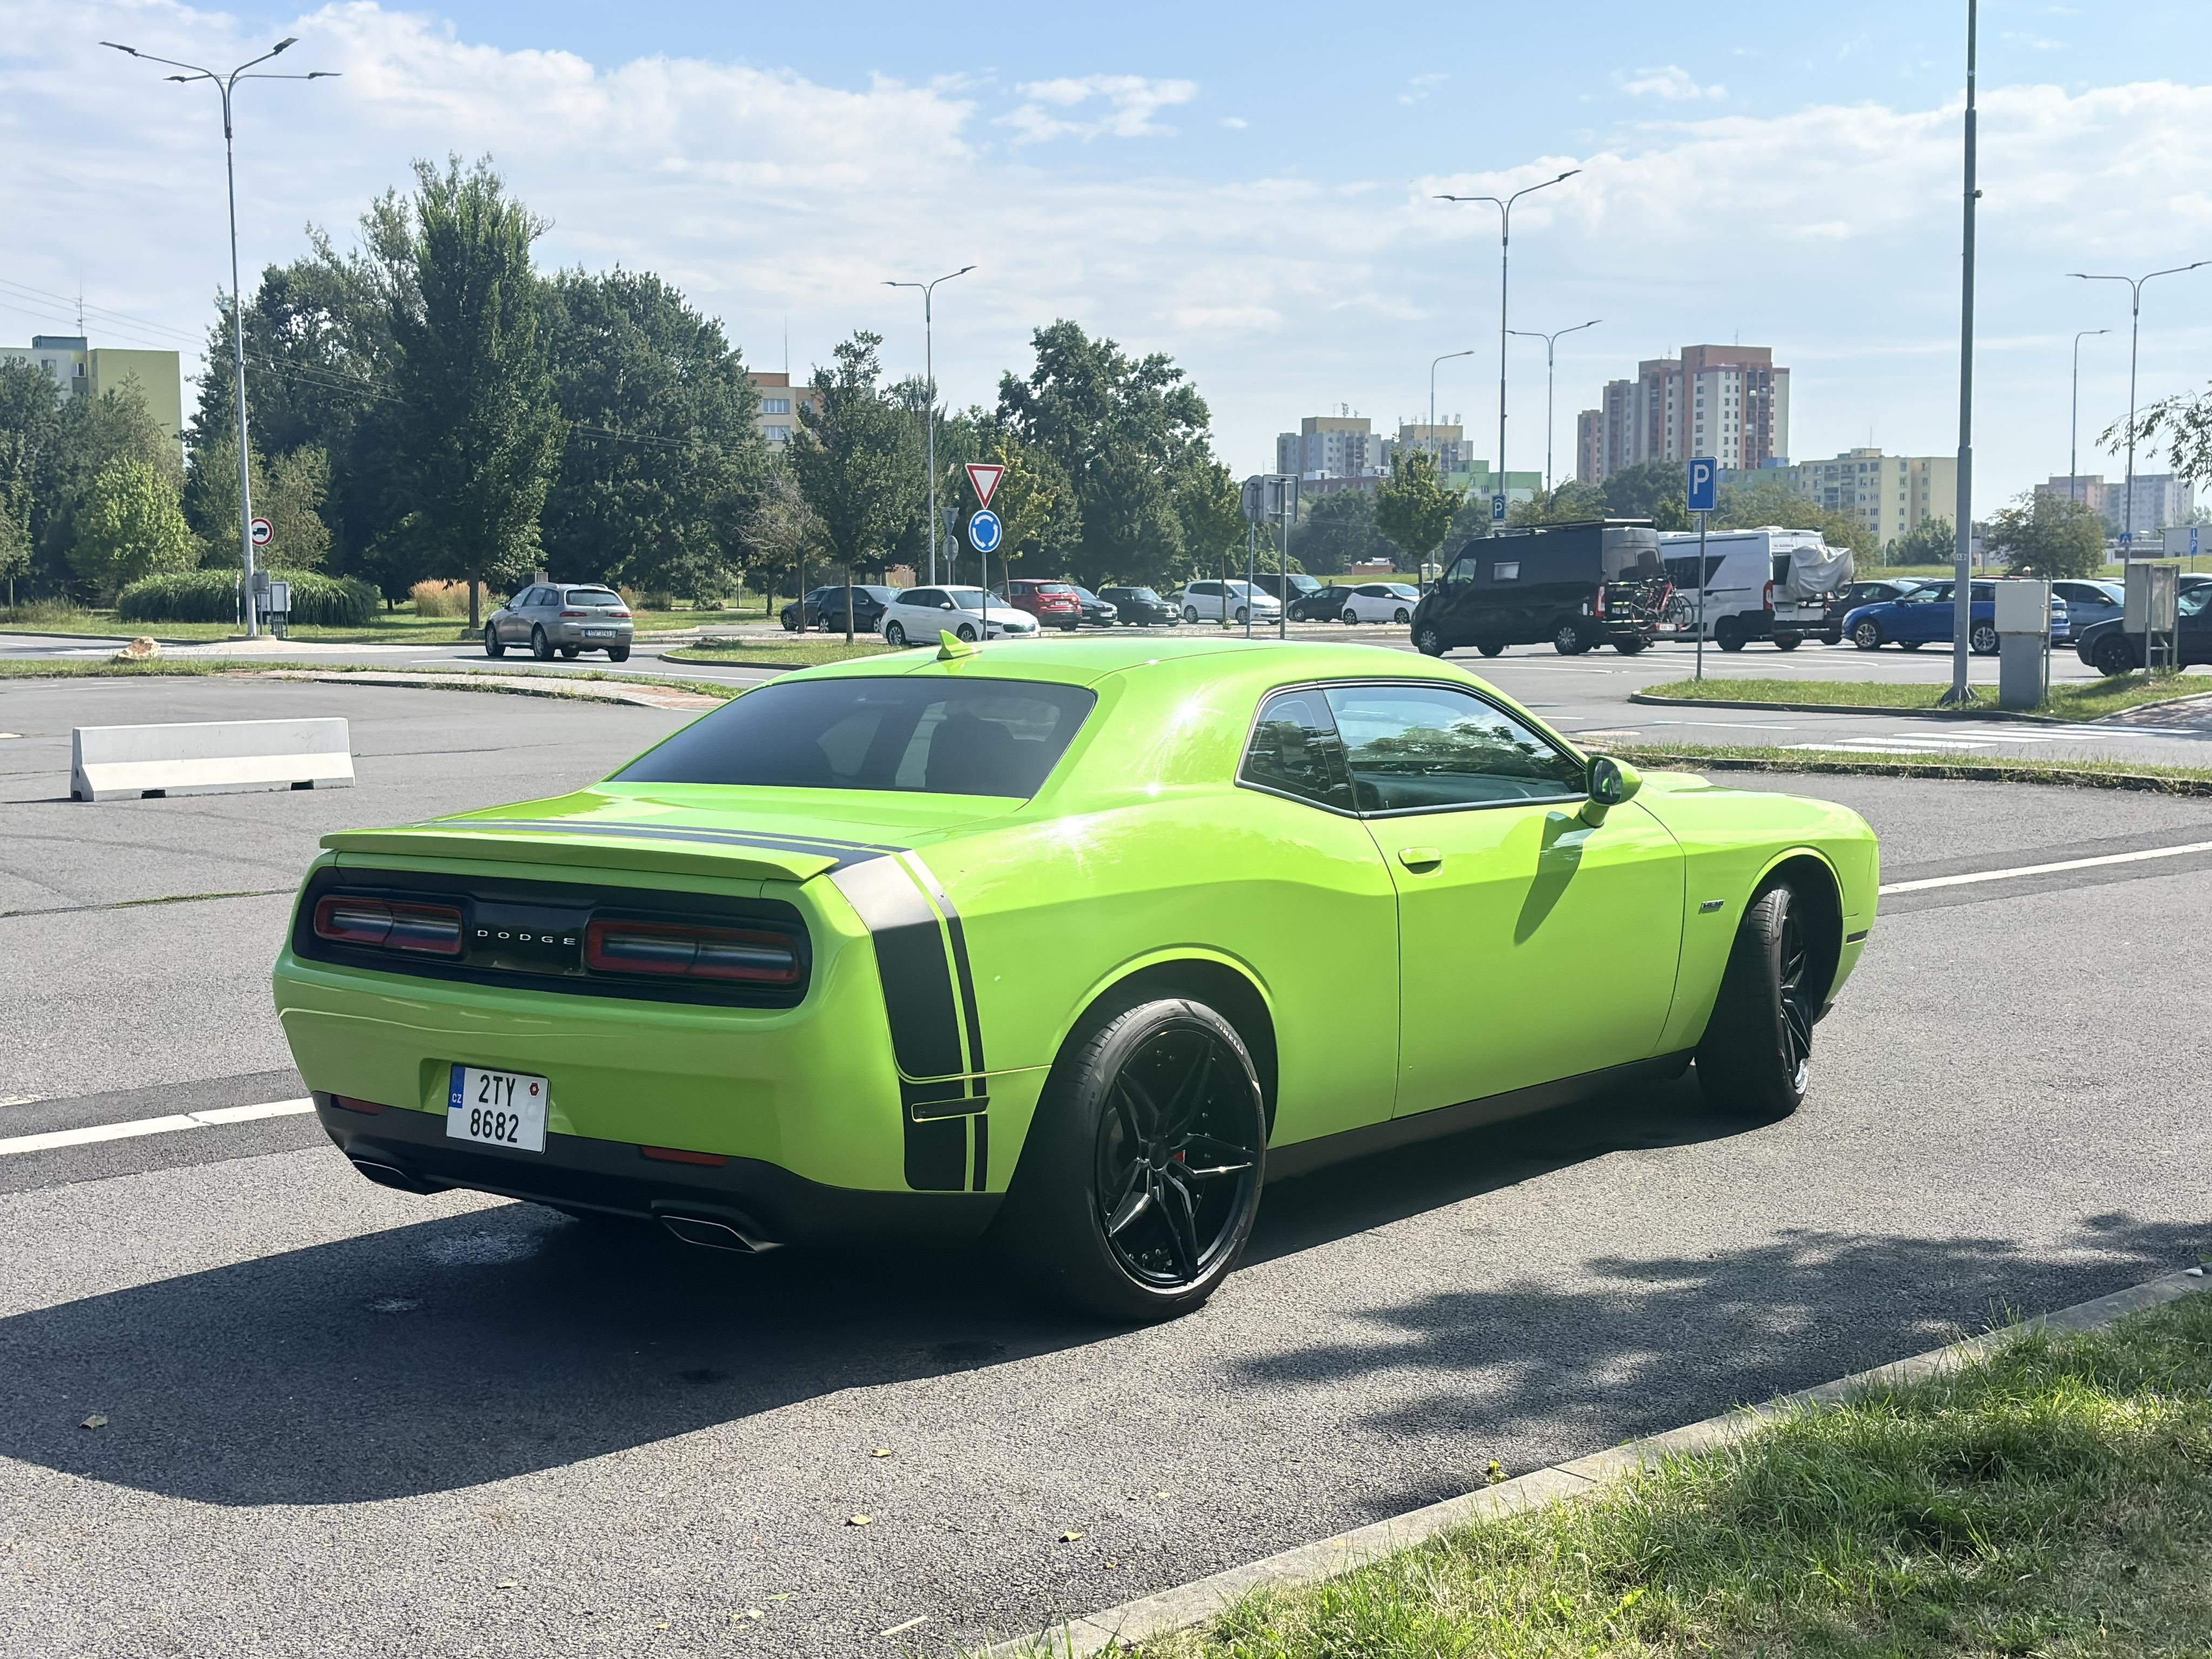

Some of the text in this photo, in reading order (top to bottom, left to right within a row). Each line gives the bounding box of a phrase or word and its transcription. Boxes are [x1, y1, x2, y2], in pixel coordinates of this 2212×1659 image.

[1693, 464, 1710, 495] P
[1494, 502, 1503, 517] P
[477, 929, 576, 945] DODGE
[451, 1092, 462, 1104] CZ
[478, 1074, 516, 1107] 2TY
[470, 1108, 520, 1144] 8682
